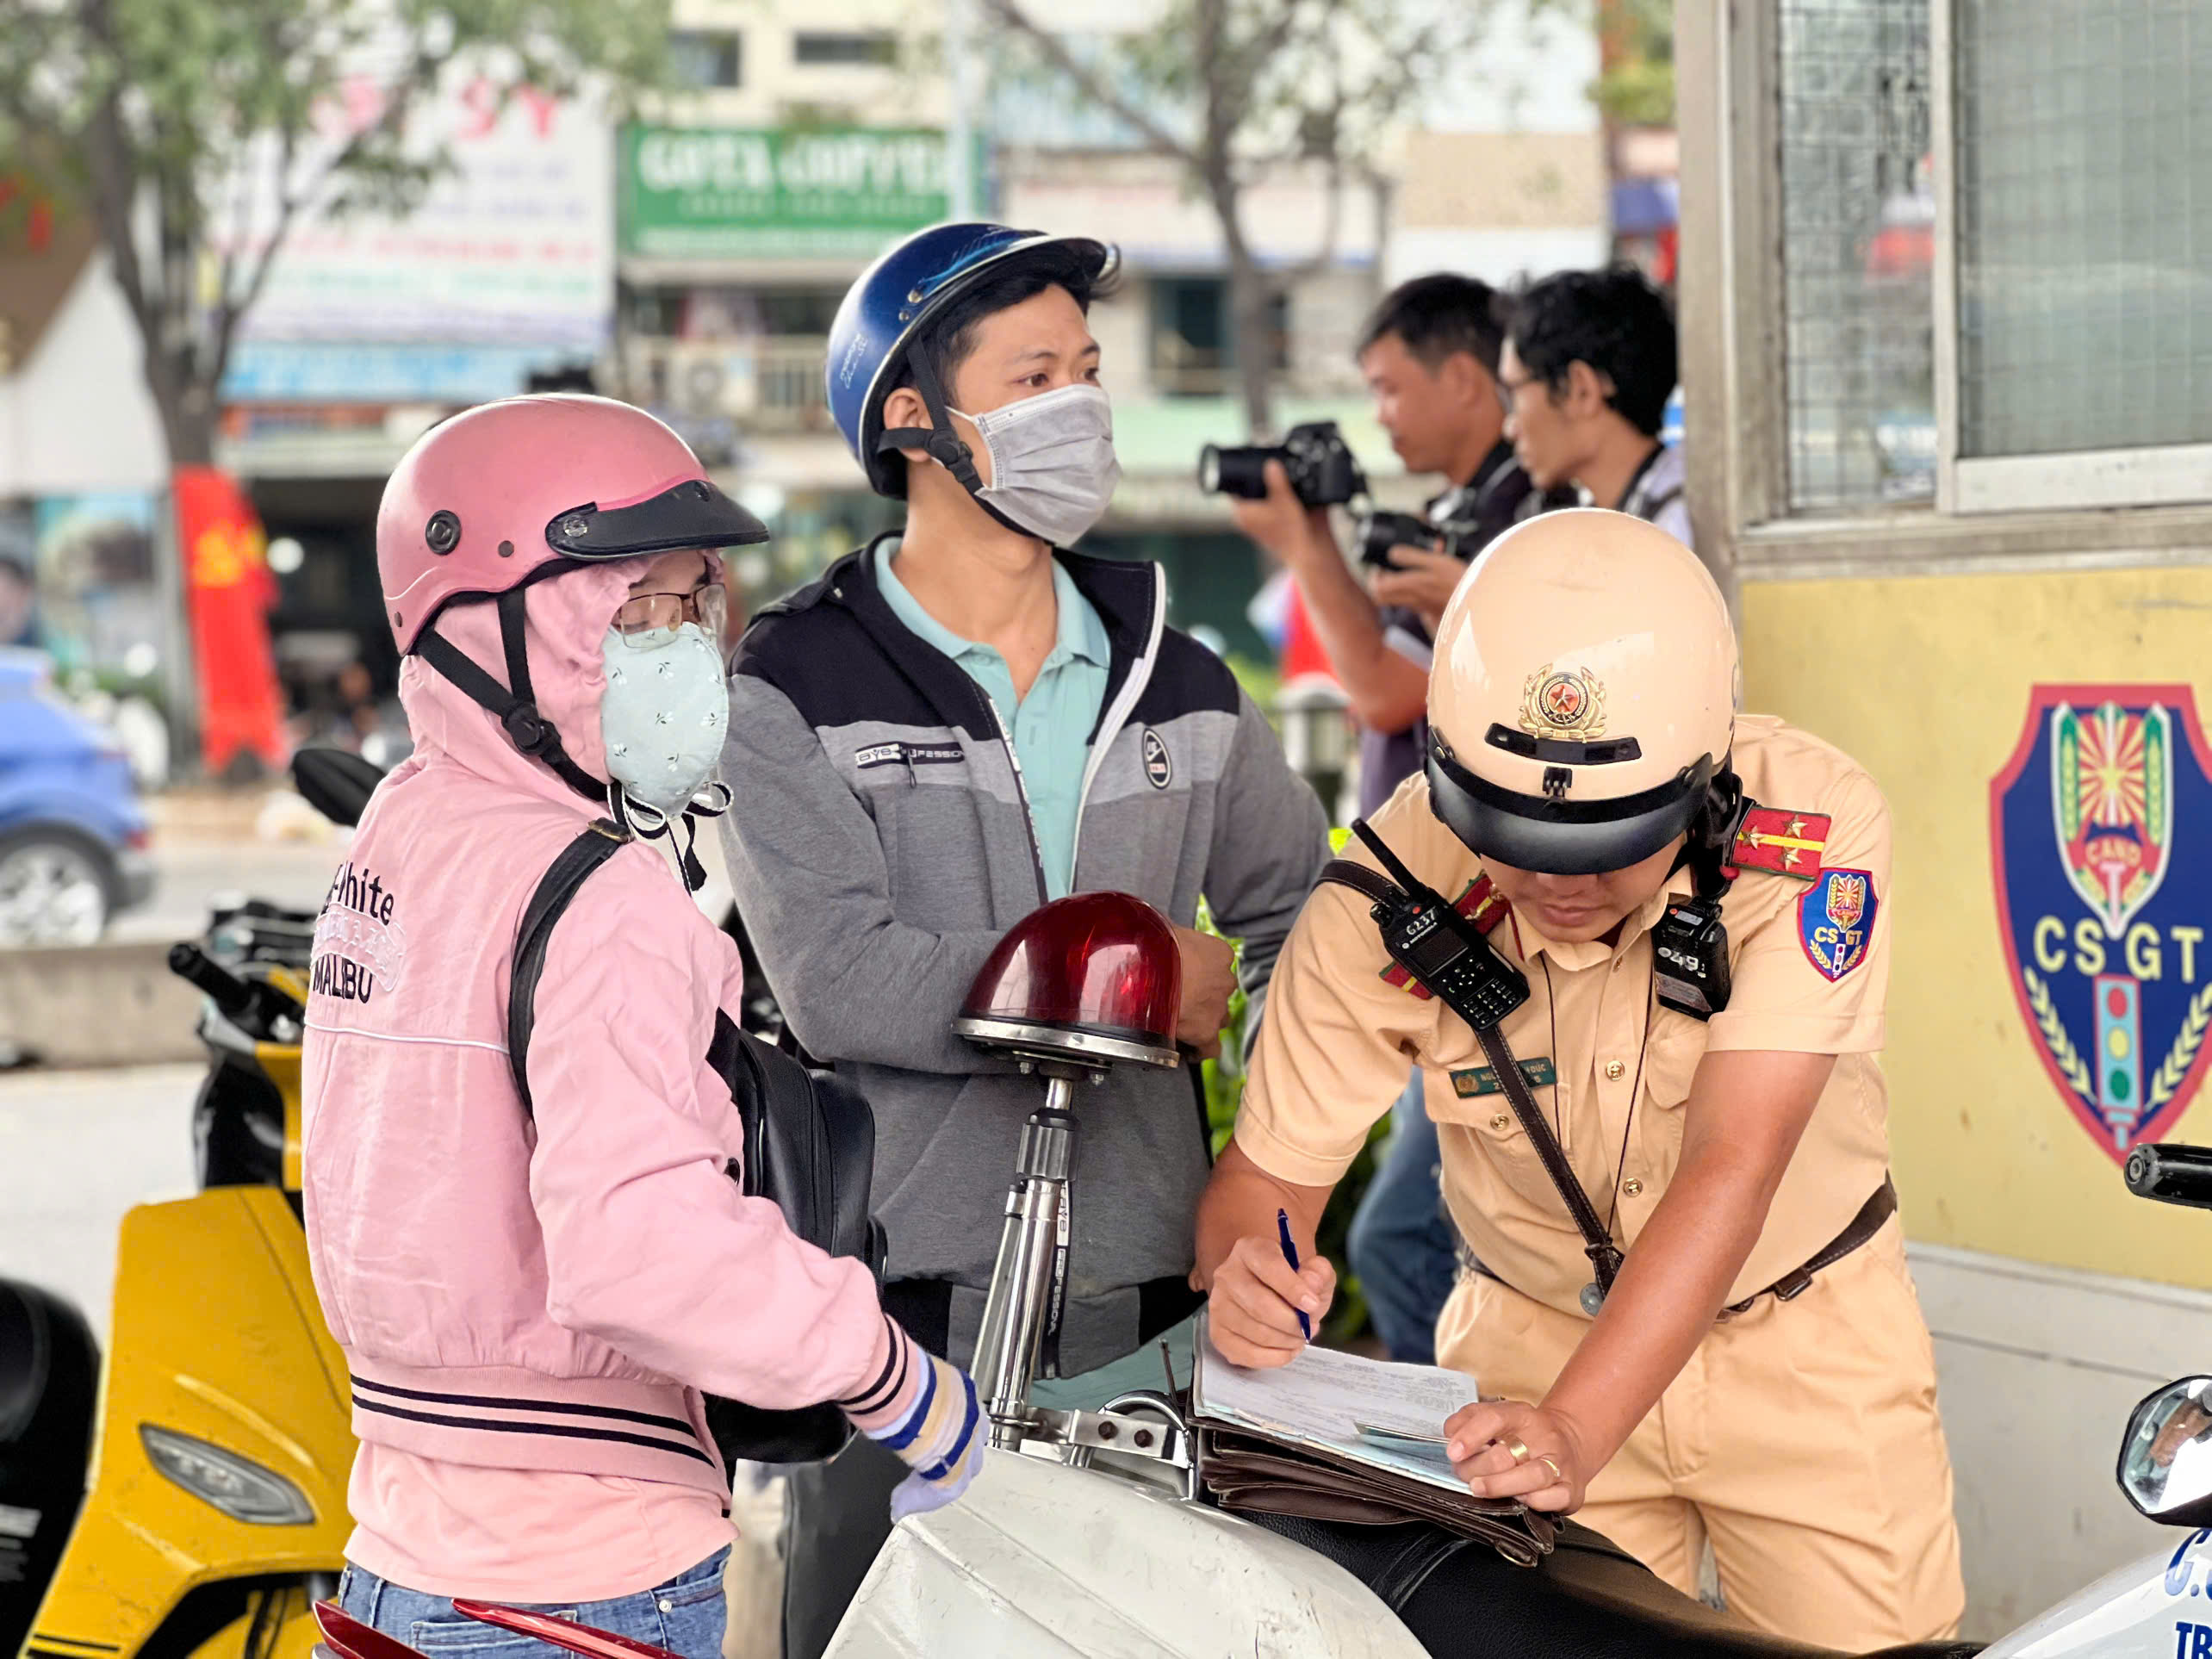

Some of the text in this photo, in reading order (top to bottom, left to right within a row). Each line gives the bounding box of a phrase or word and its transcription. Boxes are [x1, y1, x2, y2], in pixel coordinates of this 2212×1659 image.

[1406, 909, 1436, 935] G237
[1410, 922, 1438, 944] MOTOROLA
[313, 953, 373, 1003] MALIBU
